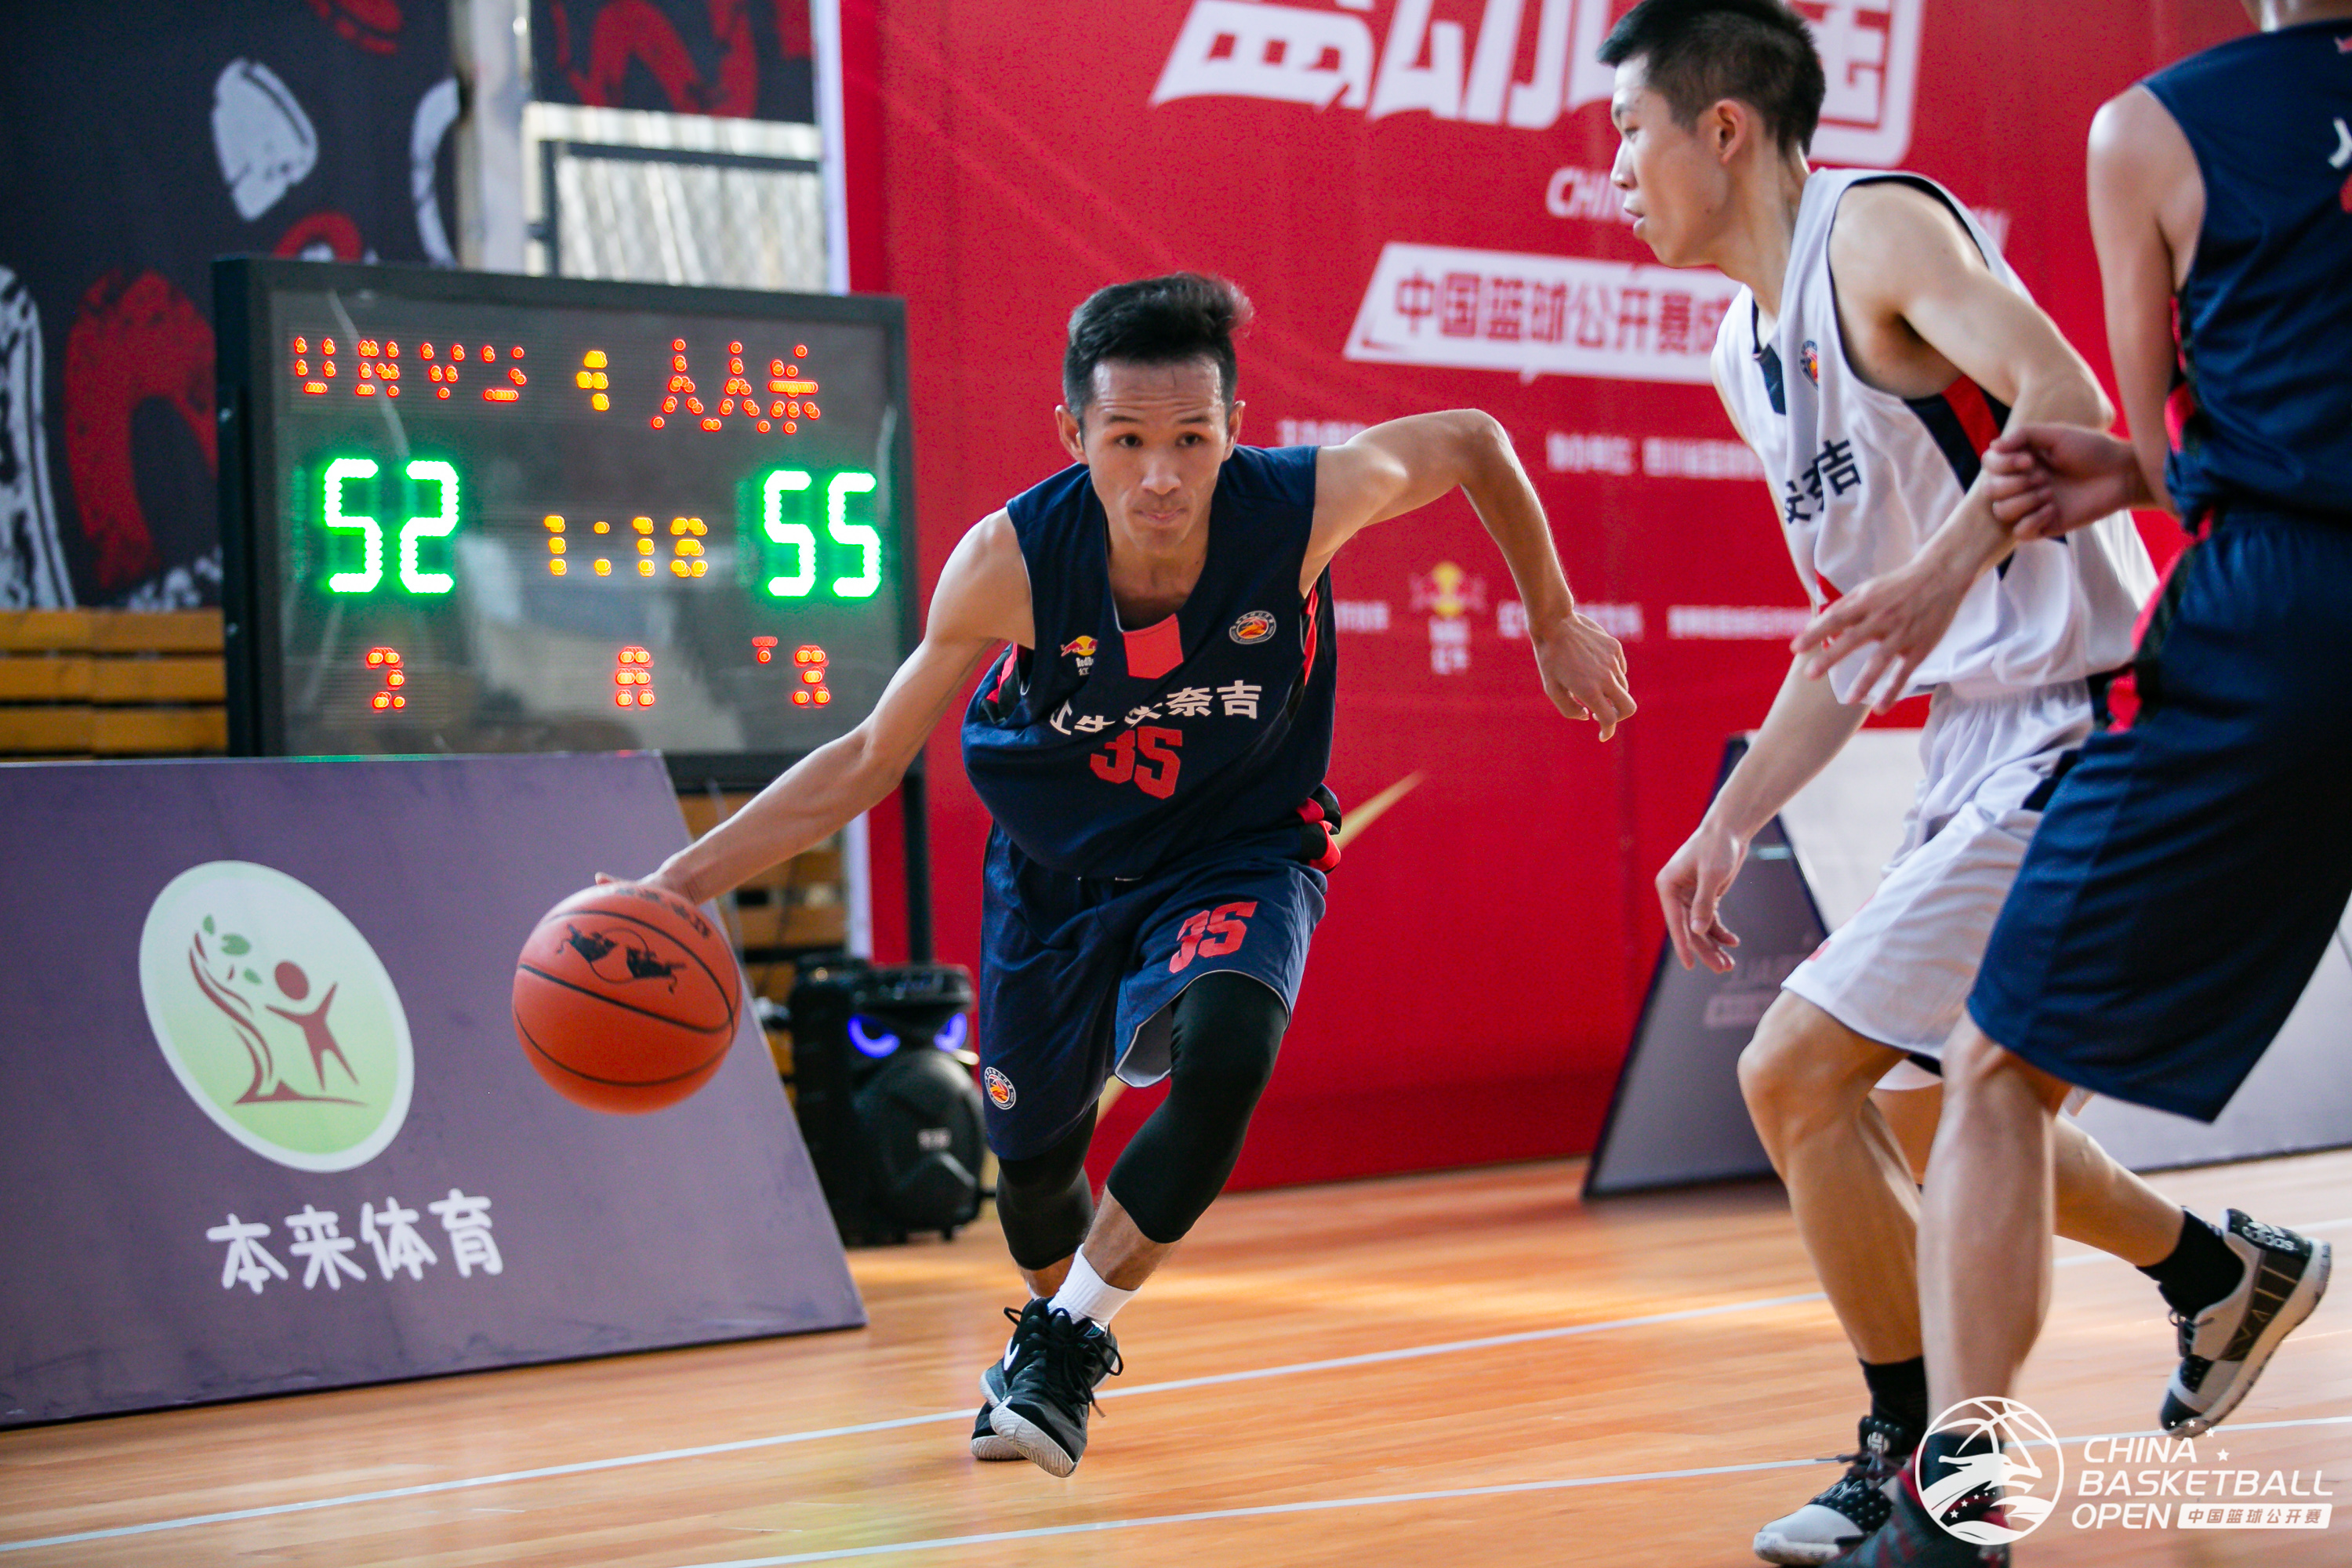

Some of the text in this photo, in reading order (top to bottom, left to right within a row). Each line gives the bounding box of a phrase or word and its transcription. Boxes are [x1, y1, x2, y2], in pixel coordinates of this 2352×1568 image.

[324, 458, 460, 594] 52
[763, 470, 882, 598] 55
[1090, 726, 1183, 800] 35
[1169, 902, 1258, 975] 35
[206, 1189, 503, 1294] 本来体育
